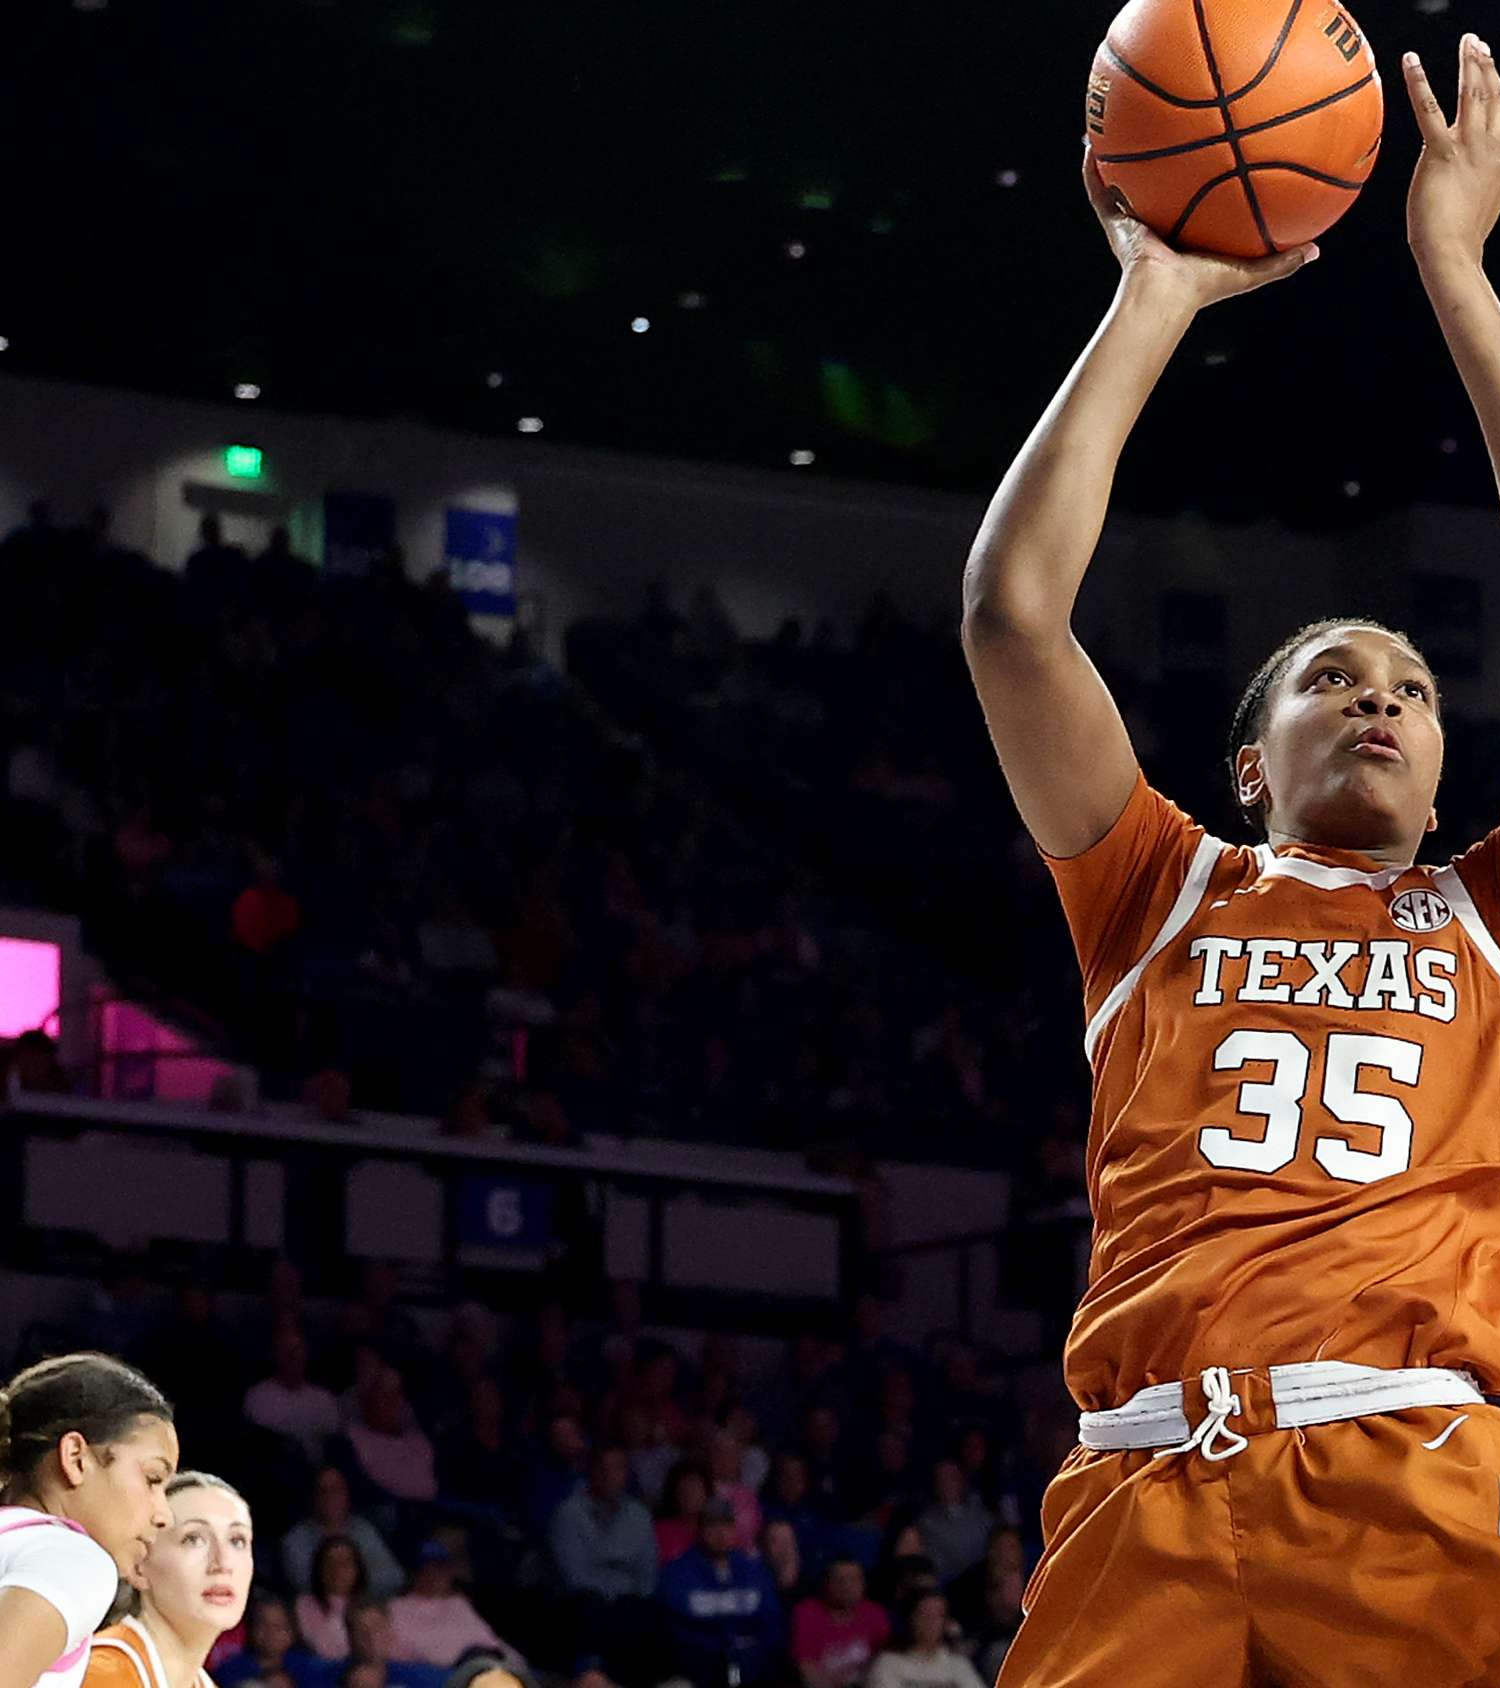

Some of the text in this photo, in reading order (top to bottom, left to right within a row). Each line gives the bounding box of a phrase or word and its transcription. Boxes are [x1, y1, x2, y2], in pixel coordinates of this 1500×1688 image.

[1392, 891, 1449, 930] SEC
[1190, 936, 1457, 1024] TEXAS
[1199, 1029, 1424, 1185] 35
